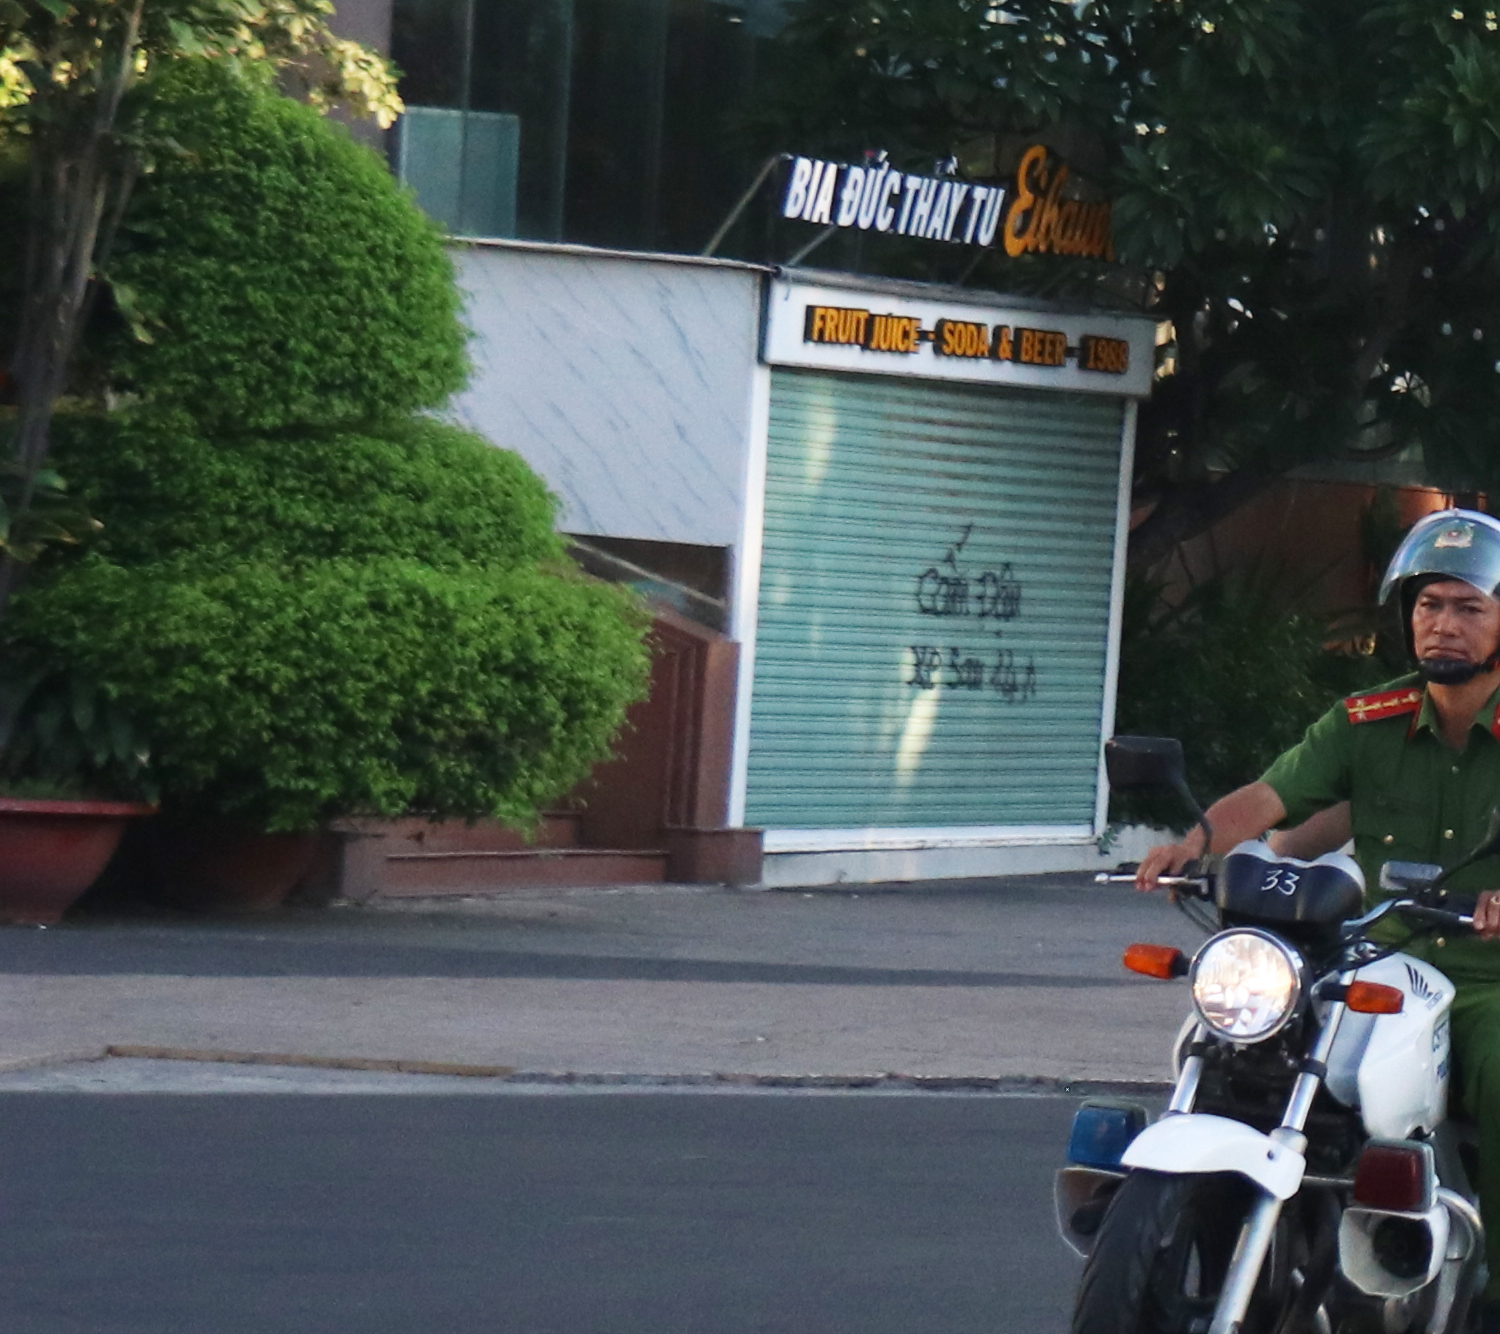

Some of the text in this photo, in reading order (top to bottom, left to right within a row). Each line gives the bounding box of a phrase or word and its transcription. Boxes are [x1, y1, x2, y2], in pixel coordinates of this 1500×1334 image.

[784, 156, 839, 225] BIA
[838, 149, 900, 233] ĐỨC
[963, 186, 1006, 248] TU
[812, 307, 869, 346] FRUIT
[868, 314, 922, 353] JUICE
[942, 320, 989, 358] SODA
[998, 326, 1013, 360] &
[1020, 328, 1066, 367] BEER
[1261, 869, 1300, 896] 33
